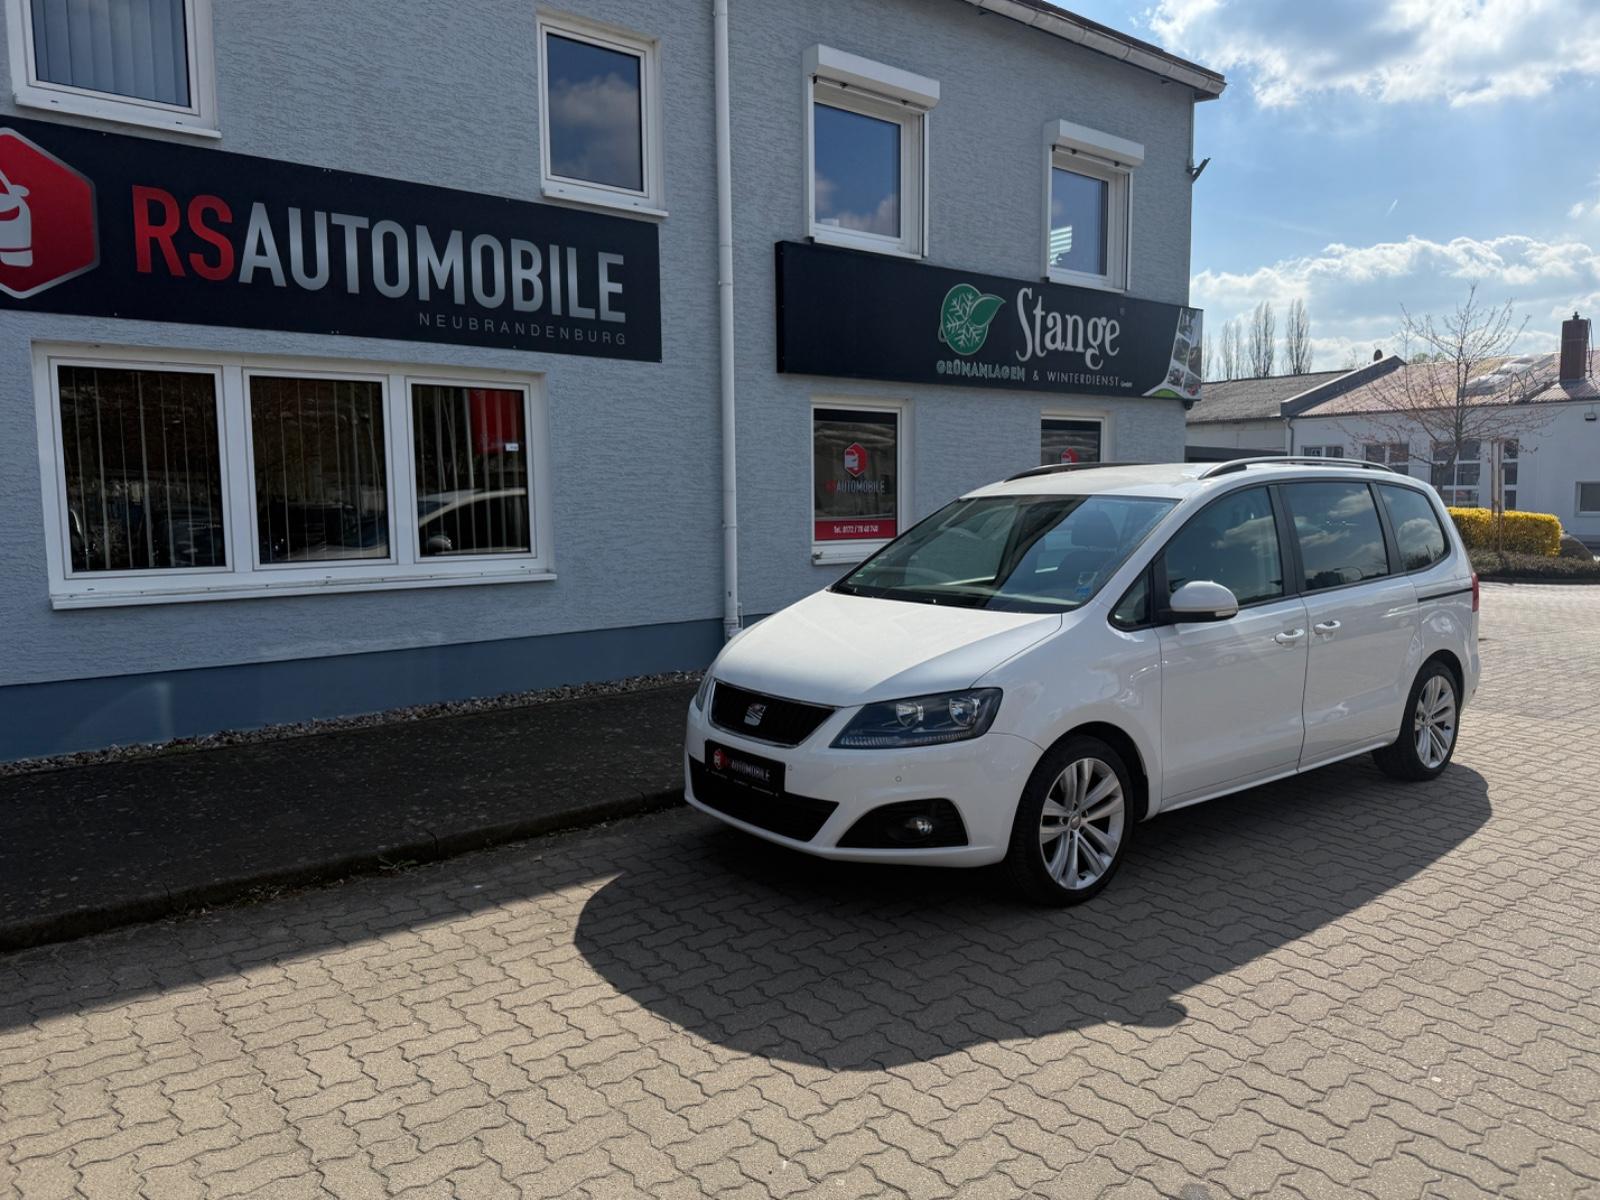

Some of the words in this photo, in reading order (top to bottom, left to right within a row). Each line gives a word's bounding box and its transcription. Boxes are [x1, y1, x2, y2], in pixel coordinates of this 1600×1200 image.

[131, 185, 626, 323] RSAUTOMOBILE
[419, 312, 627, 345] NEUBRANDENBURG
[1016, 287, 1120, 370] Stange
[1032, 369, 1040, 381] &
[1047, 371, 1120, 387] WINTERDIENST
